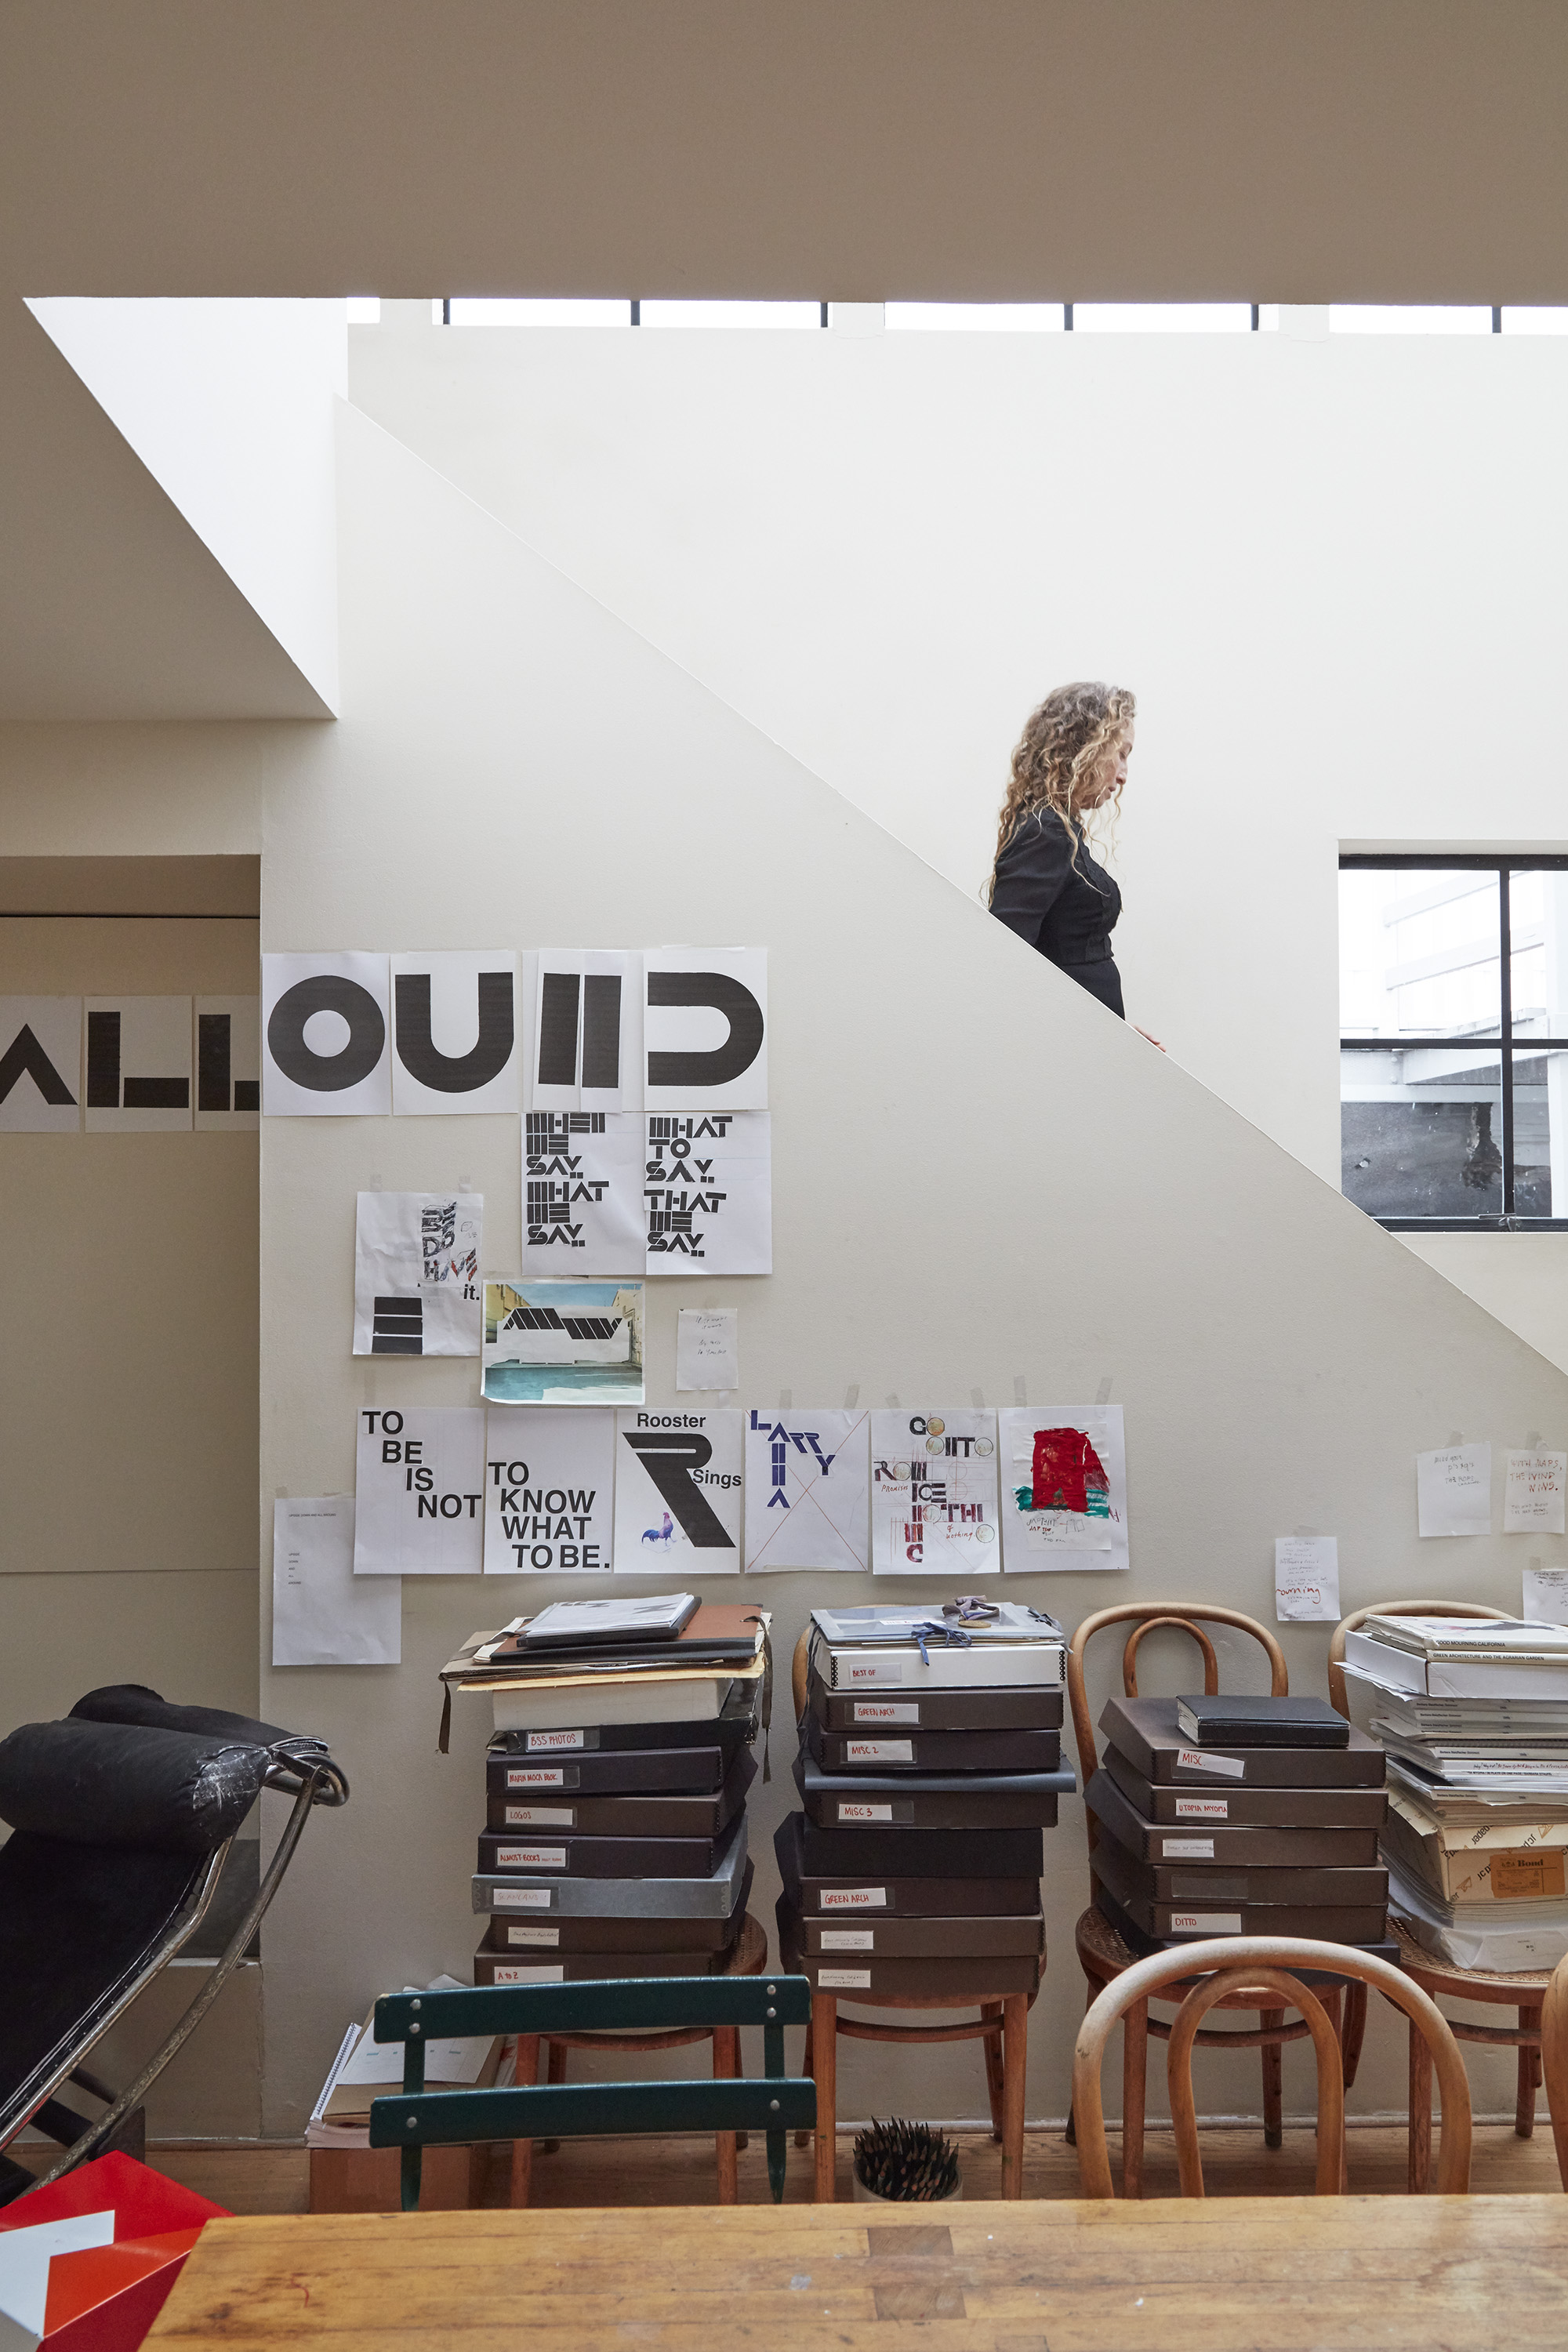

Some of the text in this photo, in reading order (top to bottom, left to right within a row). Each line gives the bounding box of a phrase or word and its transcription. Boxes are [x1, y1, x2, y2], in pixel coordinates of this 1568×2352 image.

[649, 1138, 691, 1159] TO
[644, 1189, 727, 1213] THAT
[463, 1283, 480, 1301] it.
[362, 1410, 404, 1434] TO
[637, 1413, 706, 1428] Rooster
[382, 1440, 423, 1465] BE
[406, 1468, 434, 1492] IS
[488, 1461, 529, 1486] TO
[692, 1468, 742, 1488] Sings
[1510, 1472, 1555, 1481] THE WIND
[418, 1494, 481, 1519] NOT
[500, 1489, 596, 1514] KNOW
[502, 1516, 591, 1540] WHAT
[512, 1544, 610, 1569] TO BE.
[531, 1733, 576, 1746] BSS PHOTOS
[851, 1746, 871, 1755] MISC
[510, 1811, 532, 1820] LOGOS
[845, 1807, 873, 1817] MISC 3
[825, 1894, 869, 1904] GREEN ARCH
[1174, 1918, 1196, 1926] DITTO
